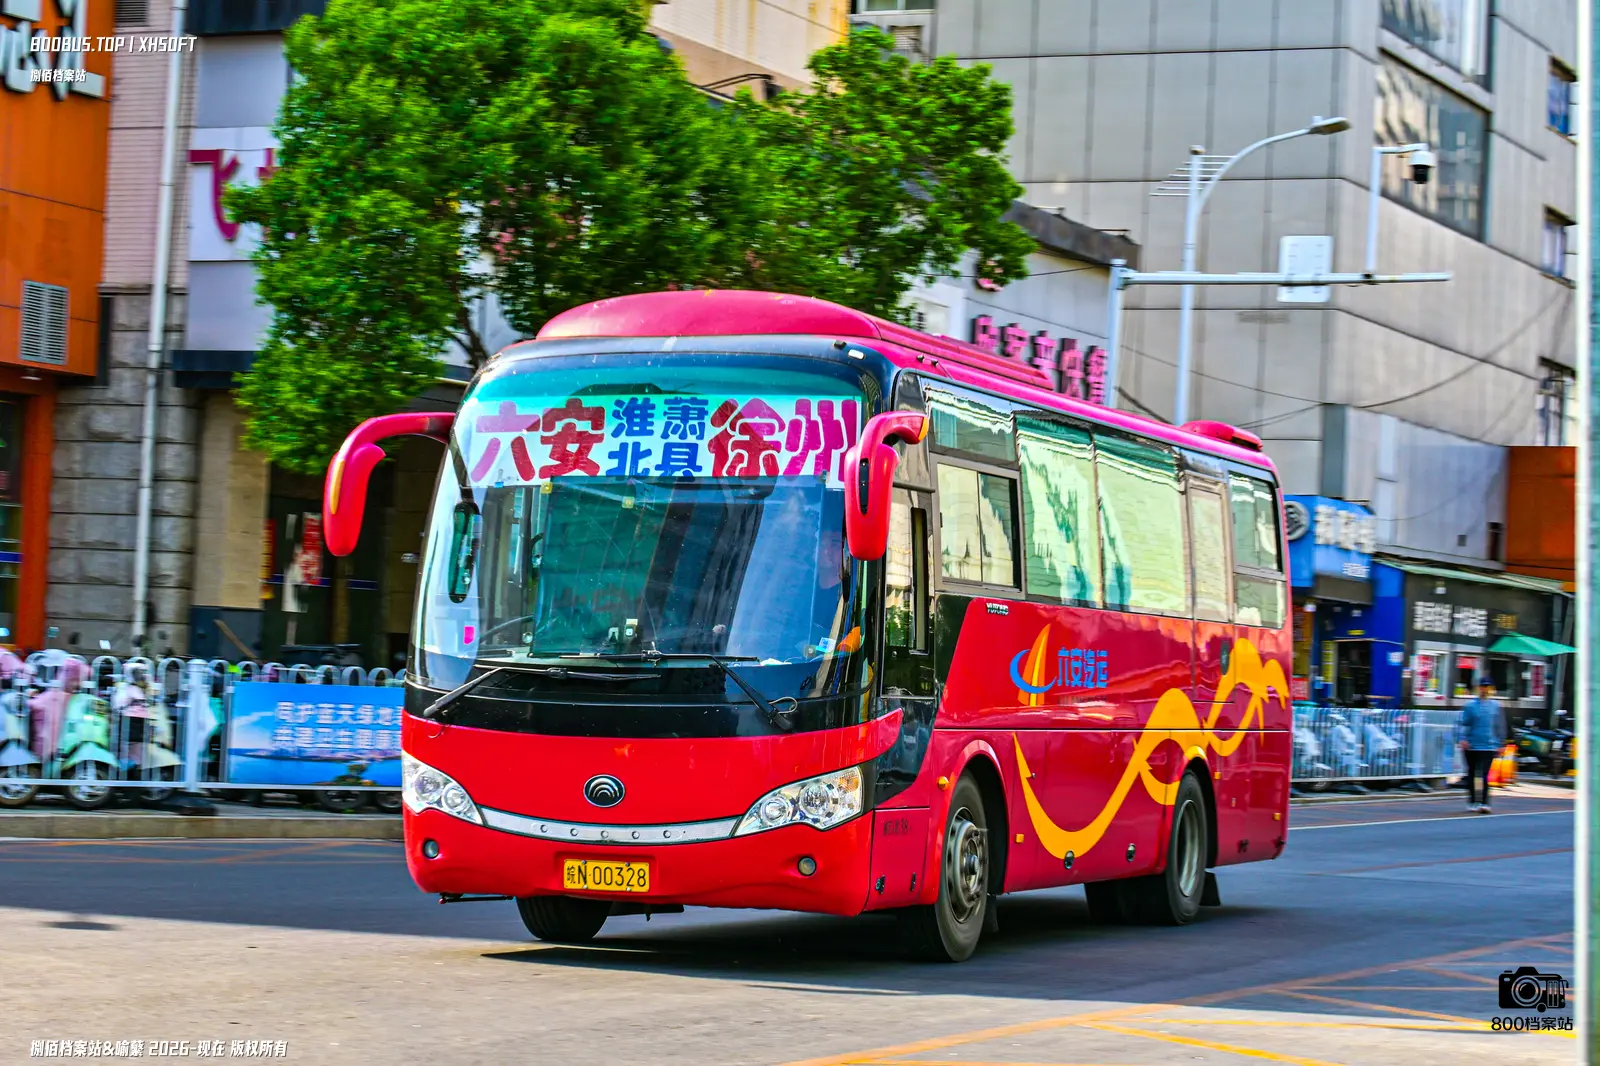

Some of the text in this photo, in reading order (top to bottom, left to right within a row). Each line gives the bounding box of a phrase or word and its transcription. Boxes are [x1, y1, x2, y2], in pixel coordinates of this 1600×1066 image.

[470, 397, 606, 483] 六安
[707, 397, 859, 483] 徐州
[1057, 647, 1108, 689] 六安汽运
